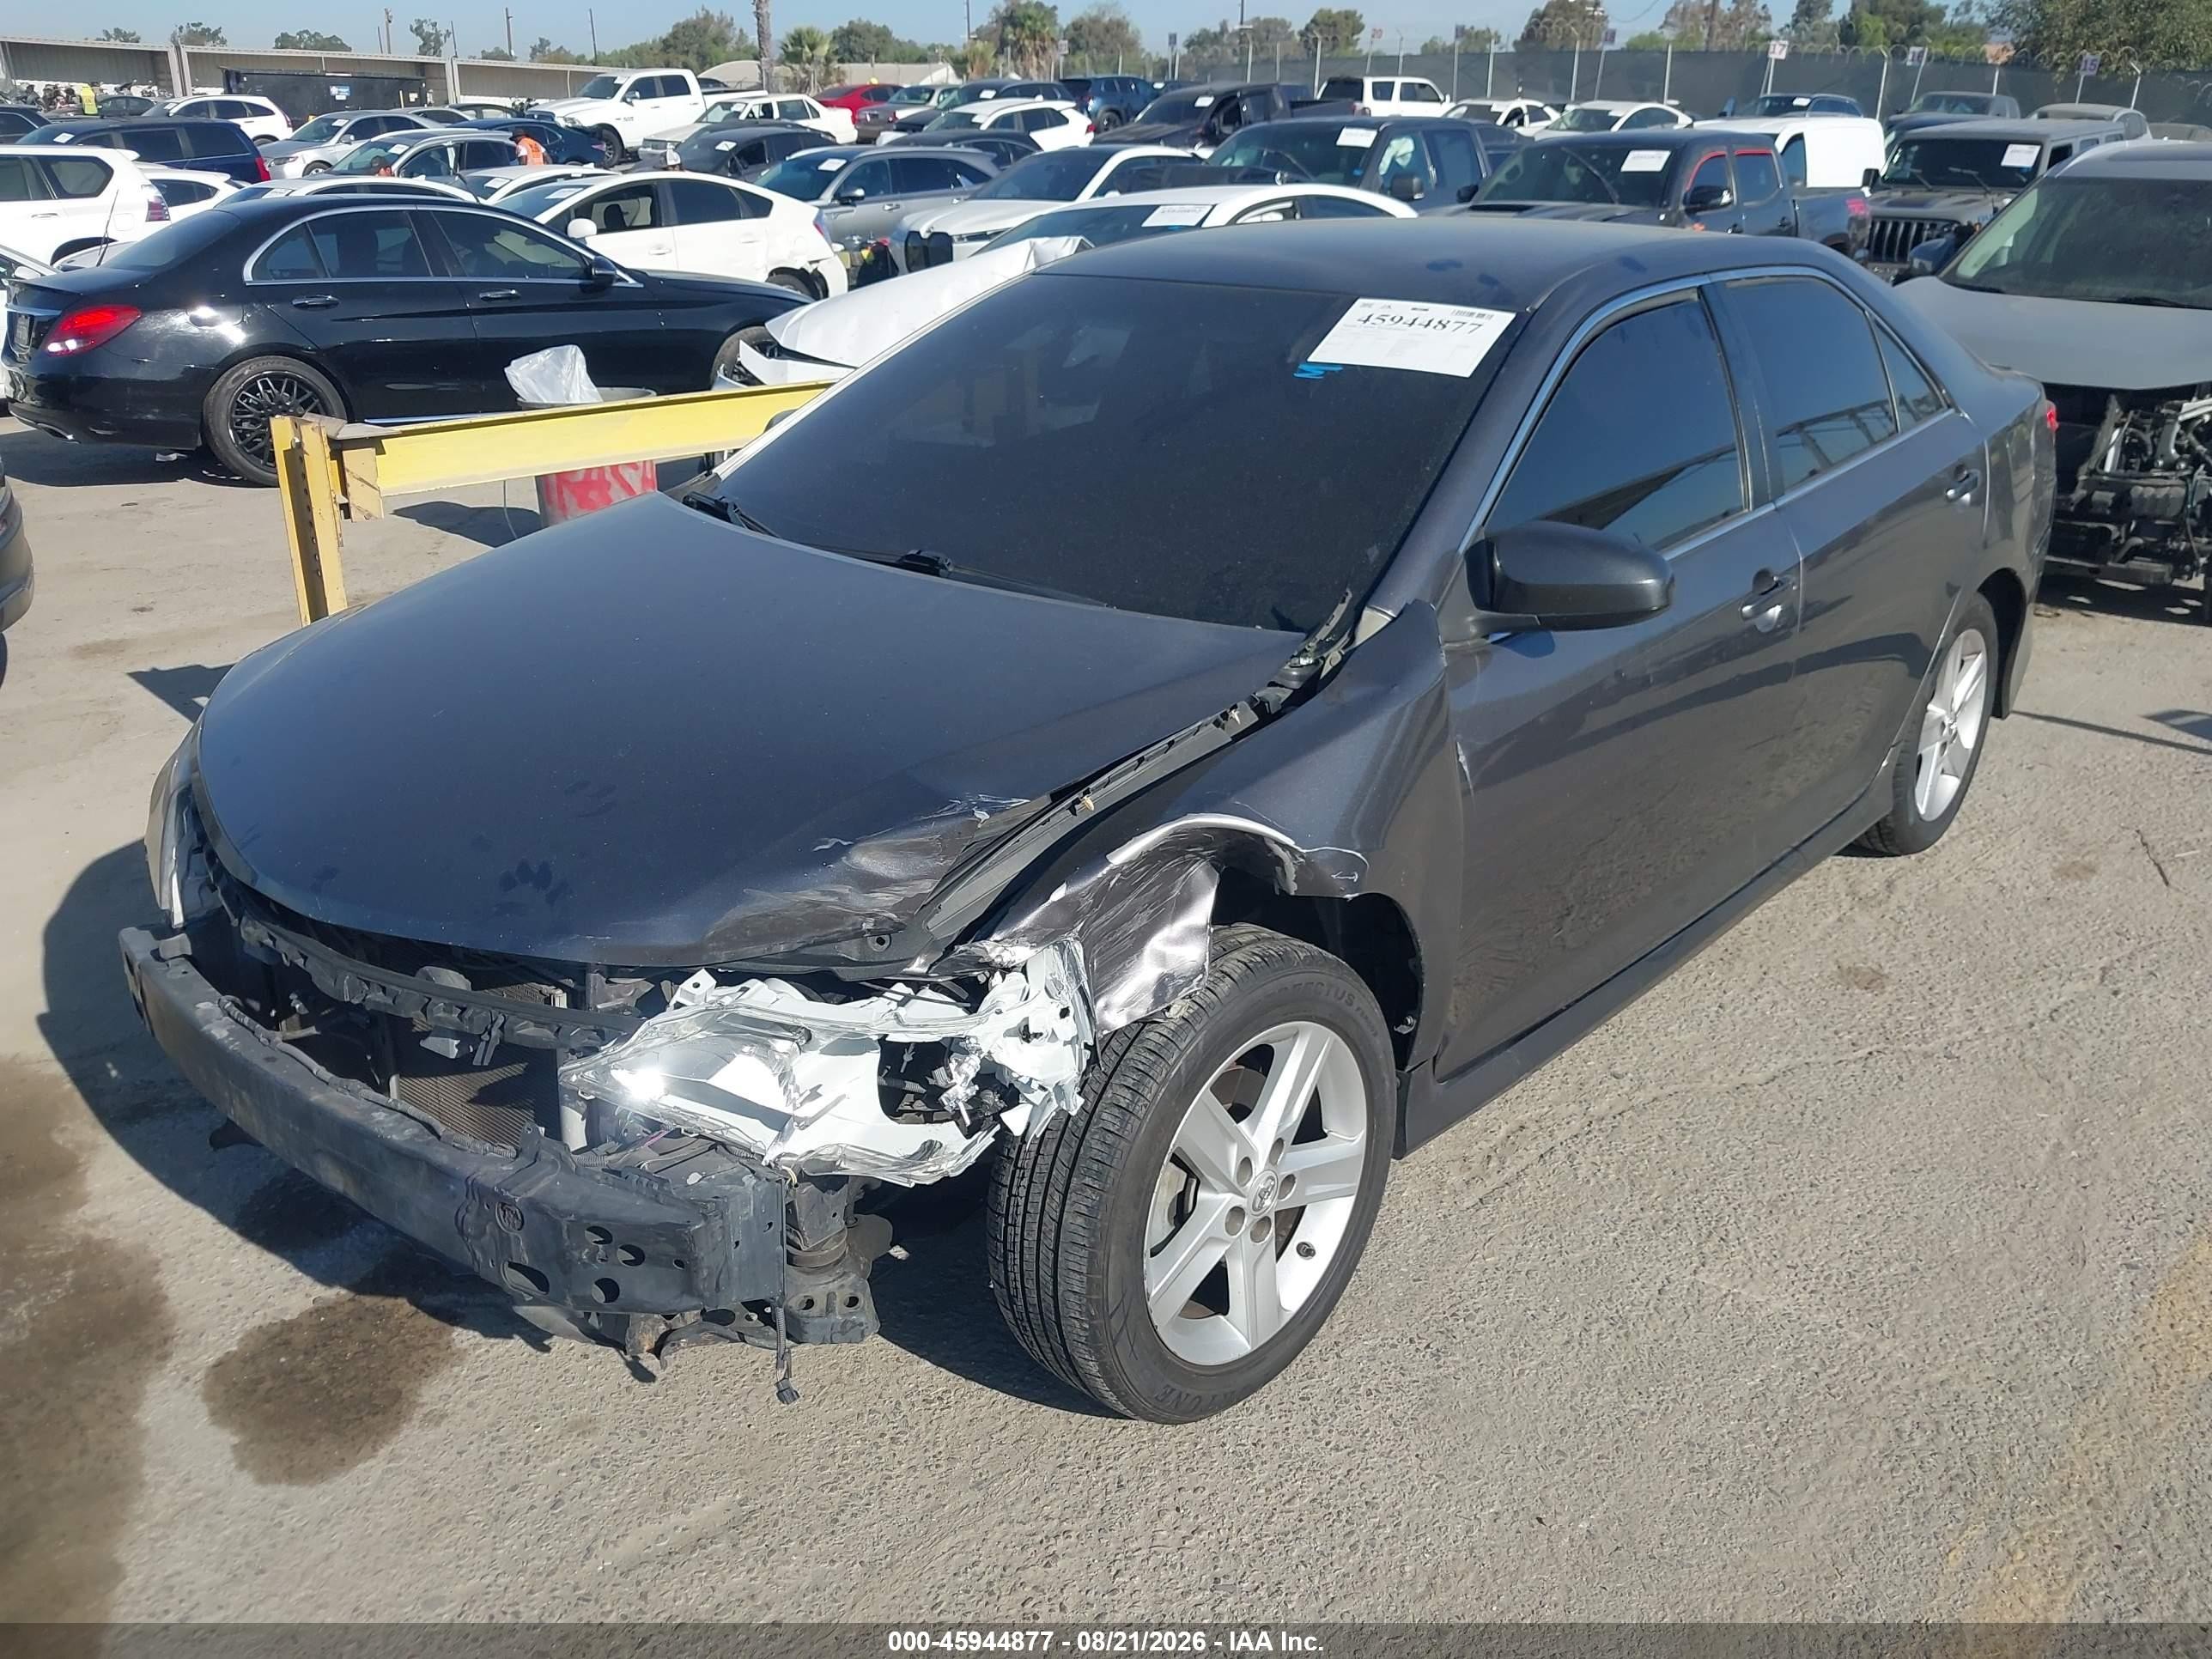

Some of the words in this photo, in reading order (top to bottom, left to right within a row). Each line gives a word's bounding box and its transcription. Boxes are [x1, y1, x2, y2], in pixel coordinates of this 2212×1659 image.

[1771, 43, 1786, 56] 17
[2083, 58, 2099, 72] 15
[1357, 313, 1485, 335] 45944877
